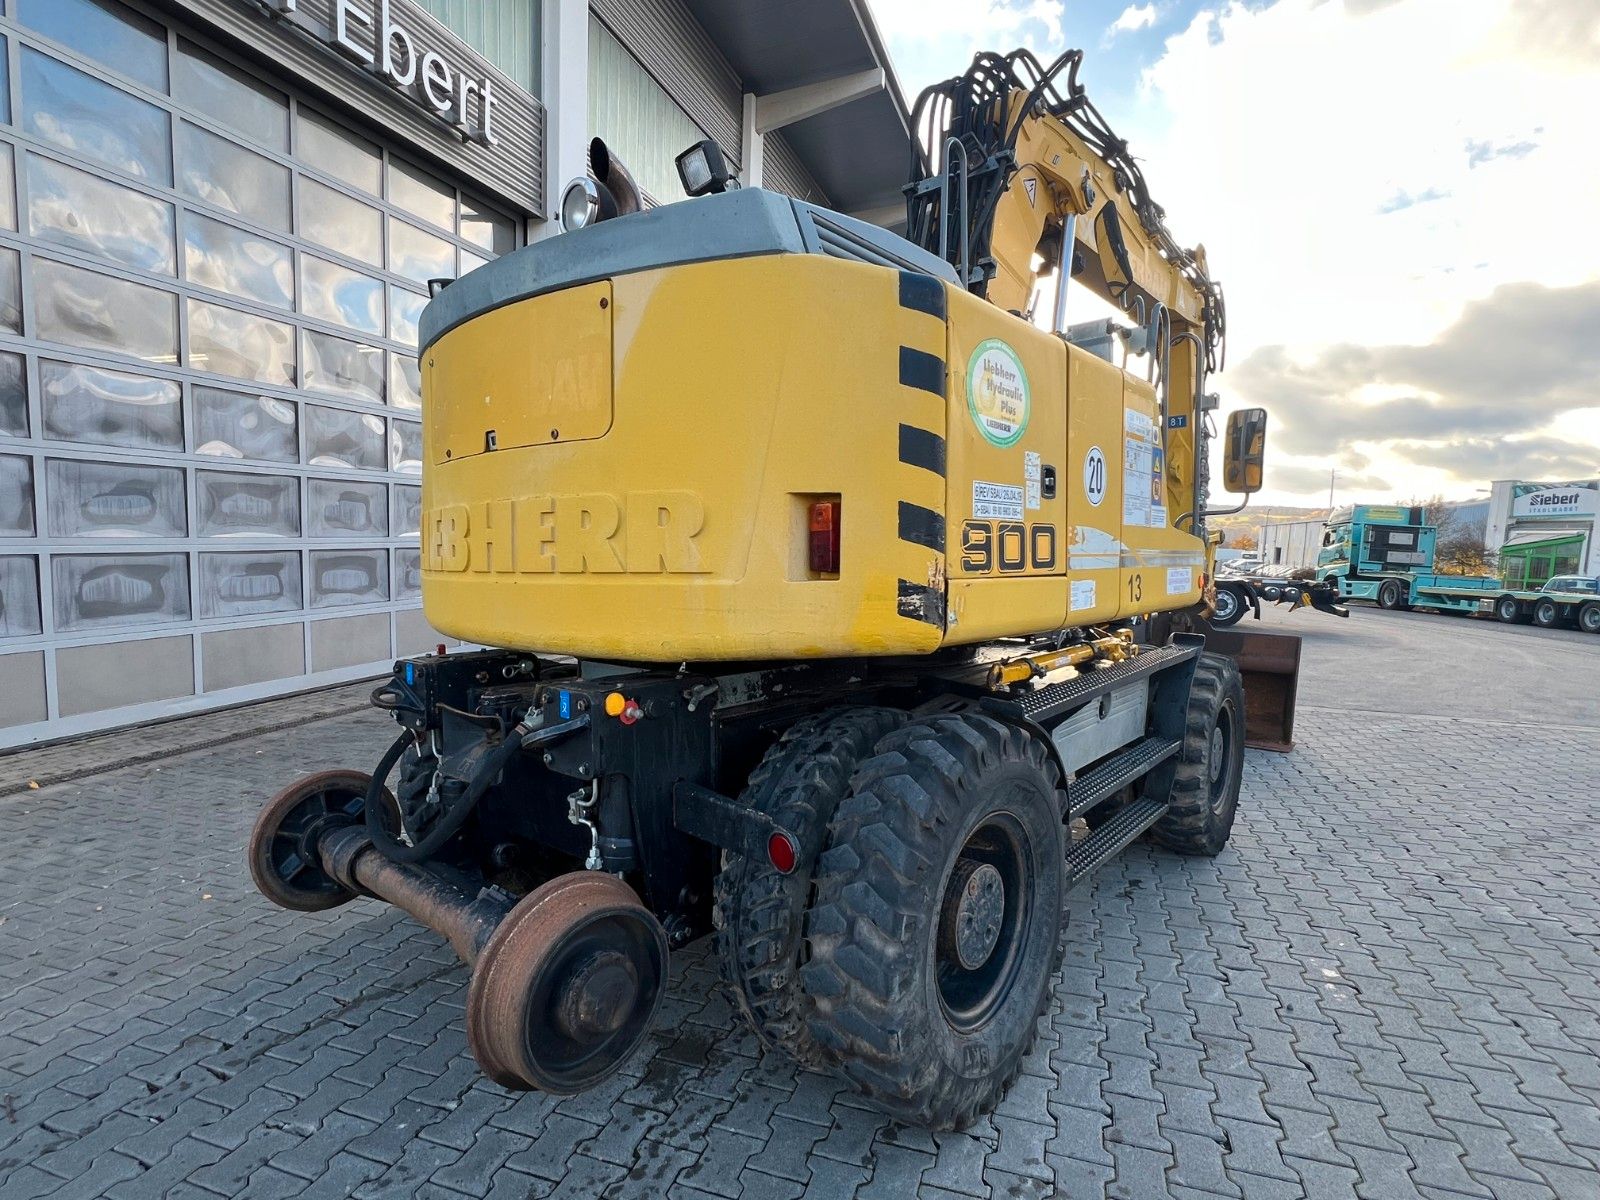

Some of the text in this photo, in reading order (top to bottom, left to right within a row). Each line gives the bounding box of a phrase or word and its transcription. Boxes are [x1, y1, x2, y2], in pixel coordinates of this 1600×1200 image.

[337, 0, 498, 145] Ebert
[983, 358, 1016, 382] Liebherr
[986, 378, 1023, 402] Hydraulic
[1000, 400, 1017, 416] Plus
[986, 418, 1011, 433] LIEBHERR
[1088, 456, 1102, 493] 20
[1530, 493, 1580, 506] Siebert
[421, 490, 712, 574] IEBHERR
[961, 519, 1056, 575] 900
[1128, 574, 1141, 602] 13
